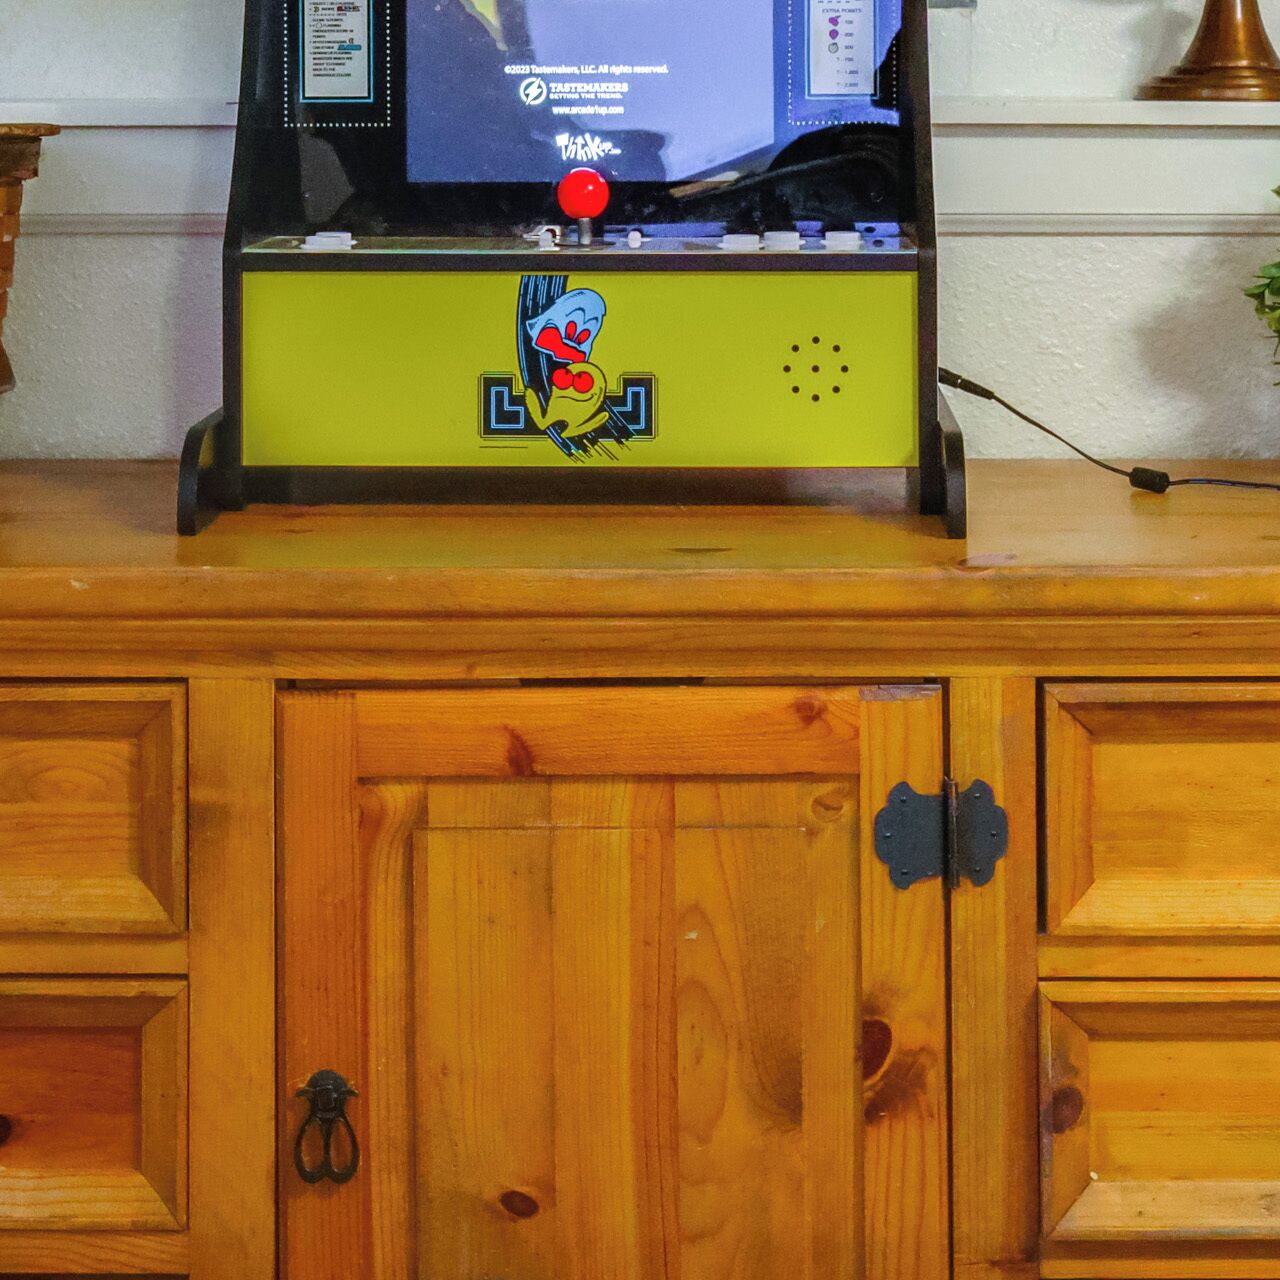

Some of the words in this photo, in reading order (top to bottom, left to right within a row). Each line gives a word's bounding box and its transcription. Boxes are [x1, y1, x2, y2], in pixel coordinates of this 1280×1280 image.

[597, 64, 609, 73] All
[610, 64, 632, 75] rights
[633, 64, 669, 73] reserved.
[549, 82, 629, 92] TASTEMAKERS
